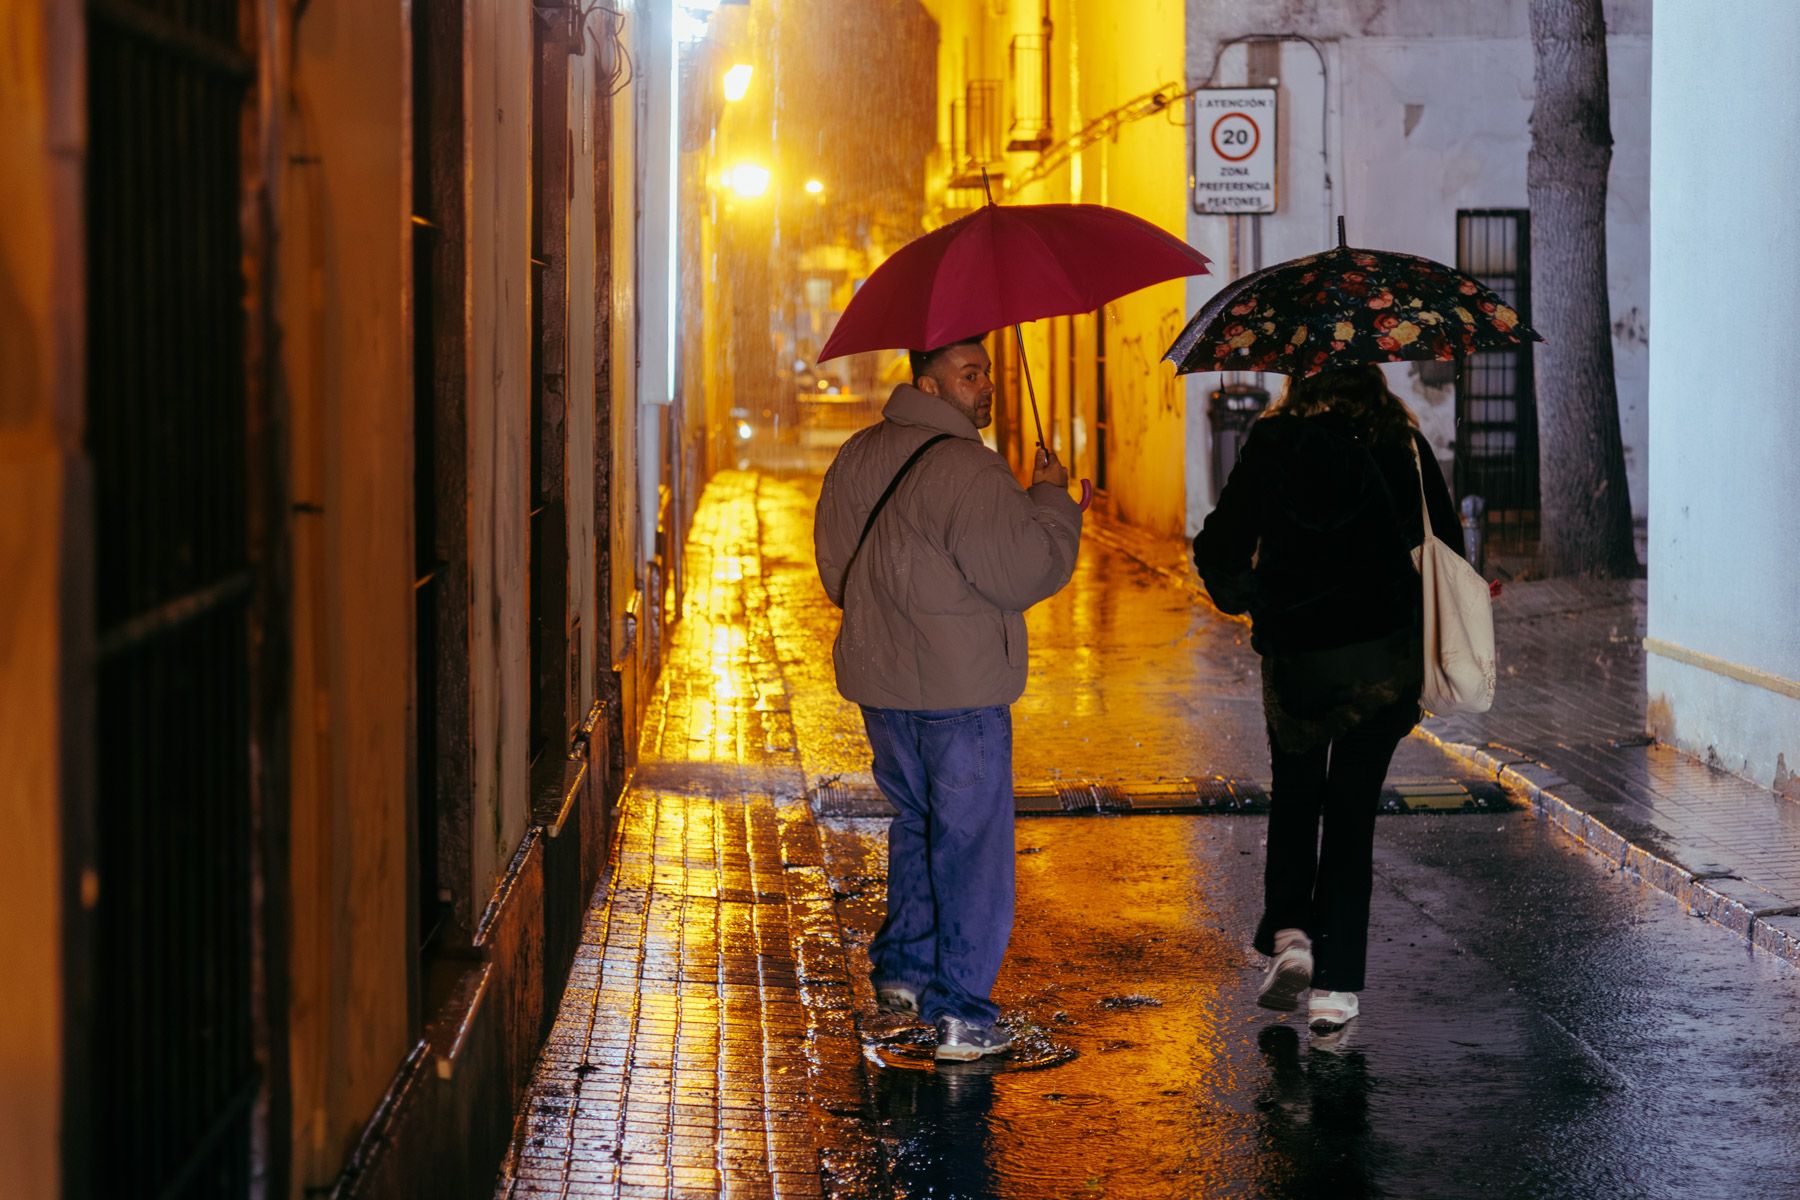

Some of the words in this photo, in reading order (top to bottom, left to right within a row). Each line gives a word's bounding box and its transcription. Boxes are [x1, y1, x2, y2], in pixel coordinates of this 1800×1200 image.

[1223, 129, 1248, 145] 20
[1220, 167, 1249, 176] ZONA
[1199, 182, 1271, 191] PREFERENCIA
[1208, 197, 1262, 206] PEATONES
